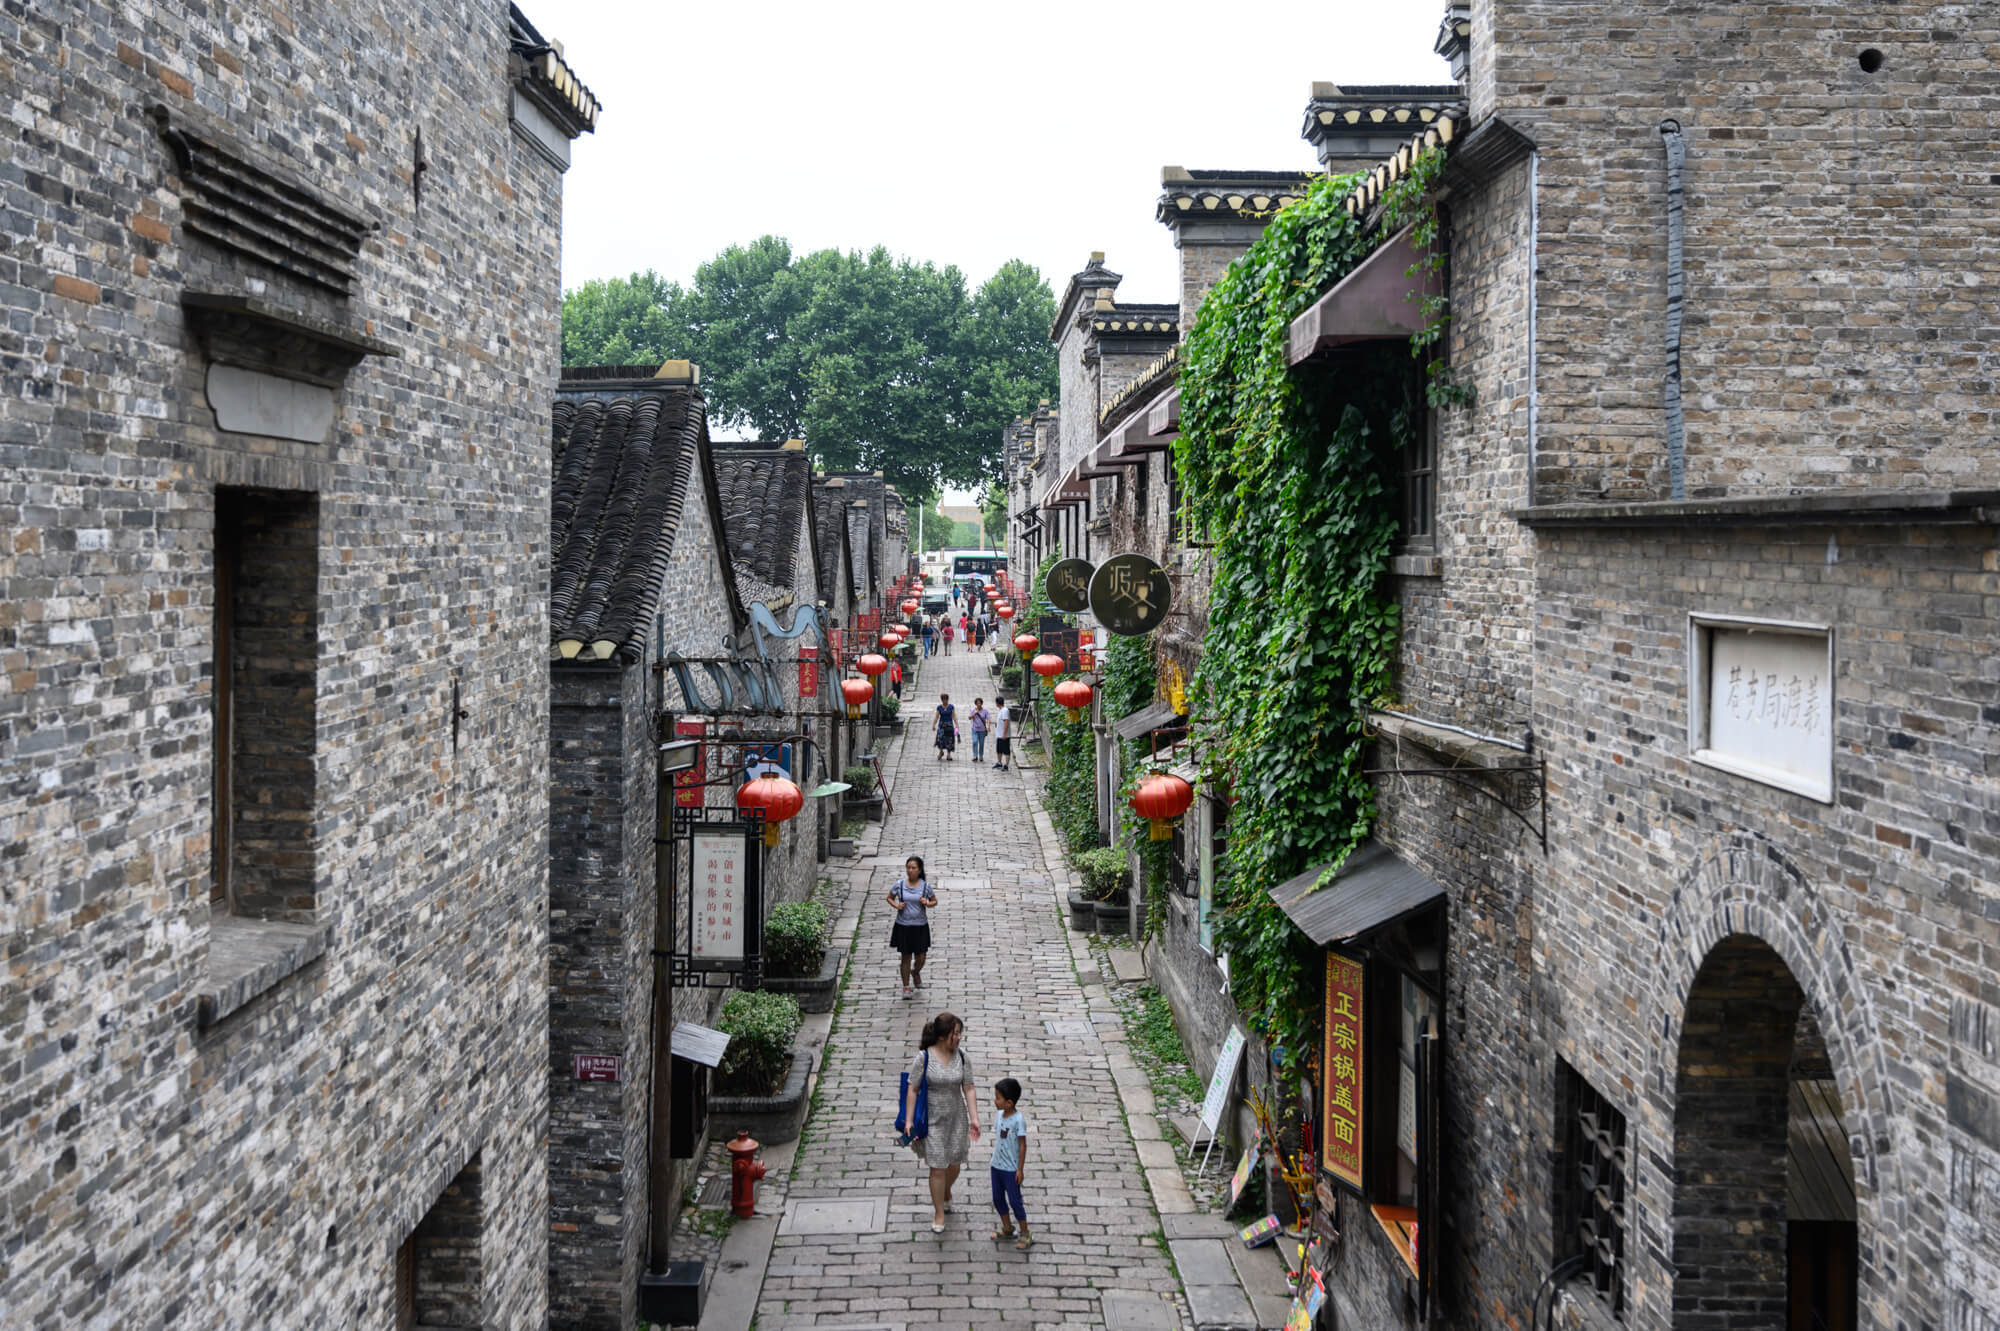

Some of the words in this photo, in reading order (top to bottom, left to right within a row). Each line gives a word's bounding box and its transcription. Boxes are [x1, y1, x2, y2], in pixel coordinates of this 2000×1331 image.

[706, 858, 719, 942] 渴望你的参与
[721, 858, 735, 942] 创建文明城市
[1331, 990, 1358, 1146] 正宗锅盖面
